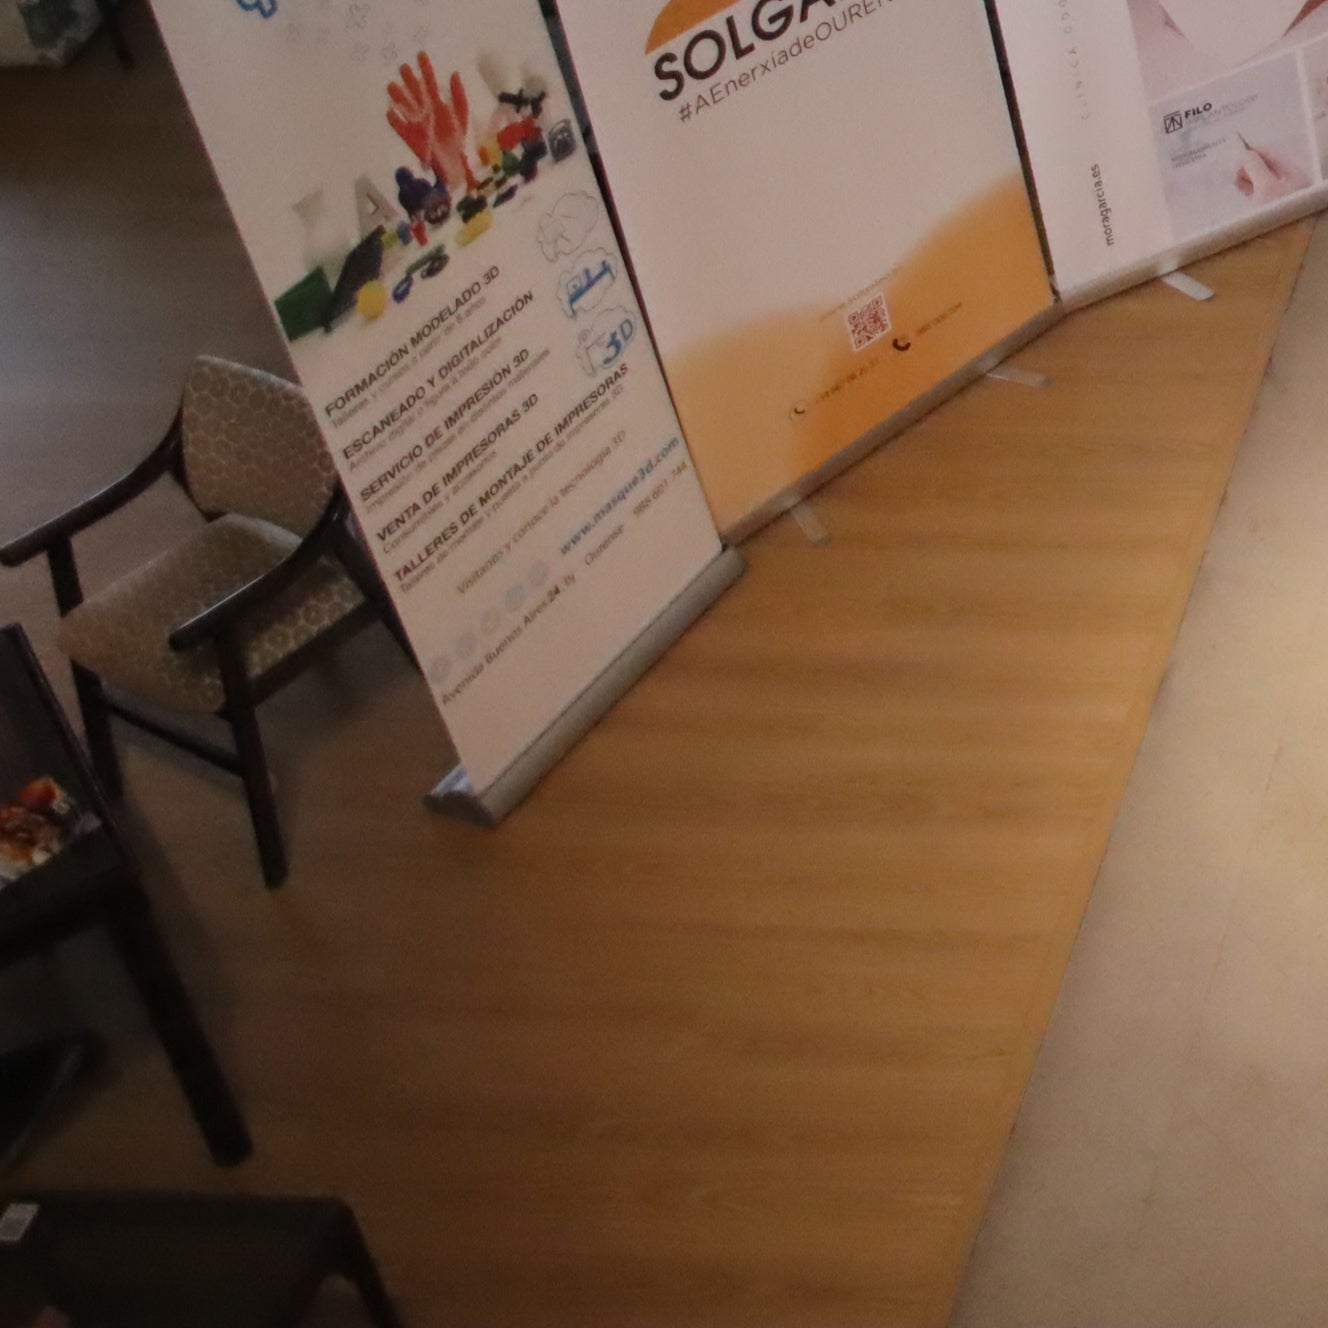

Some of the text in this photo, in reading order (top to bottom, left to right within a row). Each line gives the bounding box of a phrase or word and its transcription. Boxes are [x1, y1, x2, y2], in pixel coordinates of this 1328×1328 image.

[1183, 101, 1212, 118] FILO
[1091, 163, 1114, 247] moragarcia.es
[325, 341, 409, 419] FORMACIÓN
[409, 279, 482, 348] MODELADO
[482, 263, 500, 286] 3D
[342, 382, 426, 462] ESCANEADO
[427, 374, 436, 390] Y
[437, 288, 534, 380] DIGITALIZACIÓN
[360, 440, 423, 504] SERVICIO
[423, 423, 443, 448] DE
[443, 361, 512, 430] IMPRESIÓN
[511, 345, 530, 369] 3D
[376, 391, 539, 545] VENTA DE IMPRESORAS 3D
[394, 519, 458, 585] TALLERES
[459, 501, 477, 525] DE
[478, 447, 535, 508] MONTAJE
[535, 430, 553, 453] DE
[554, 361, 629, 437] IMPRESORAS
[611, 427, 627, 449] 3D
